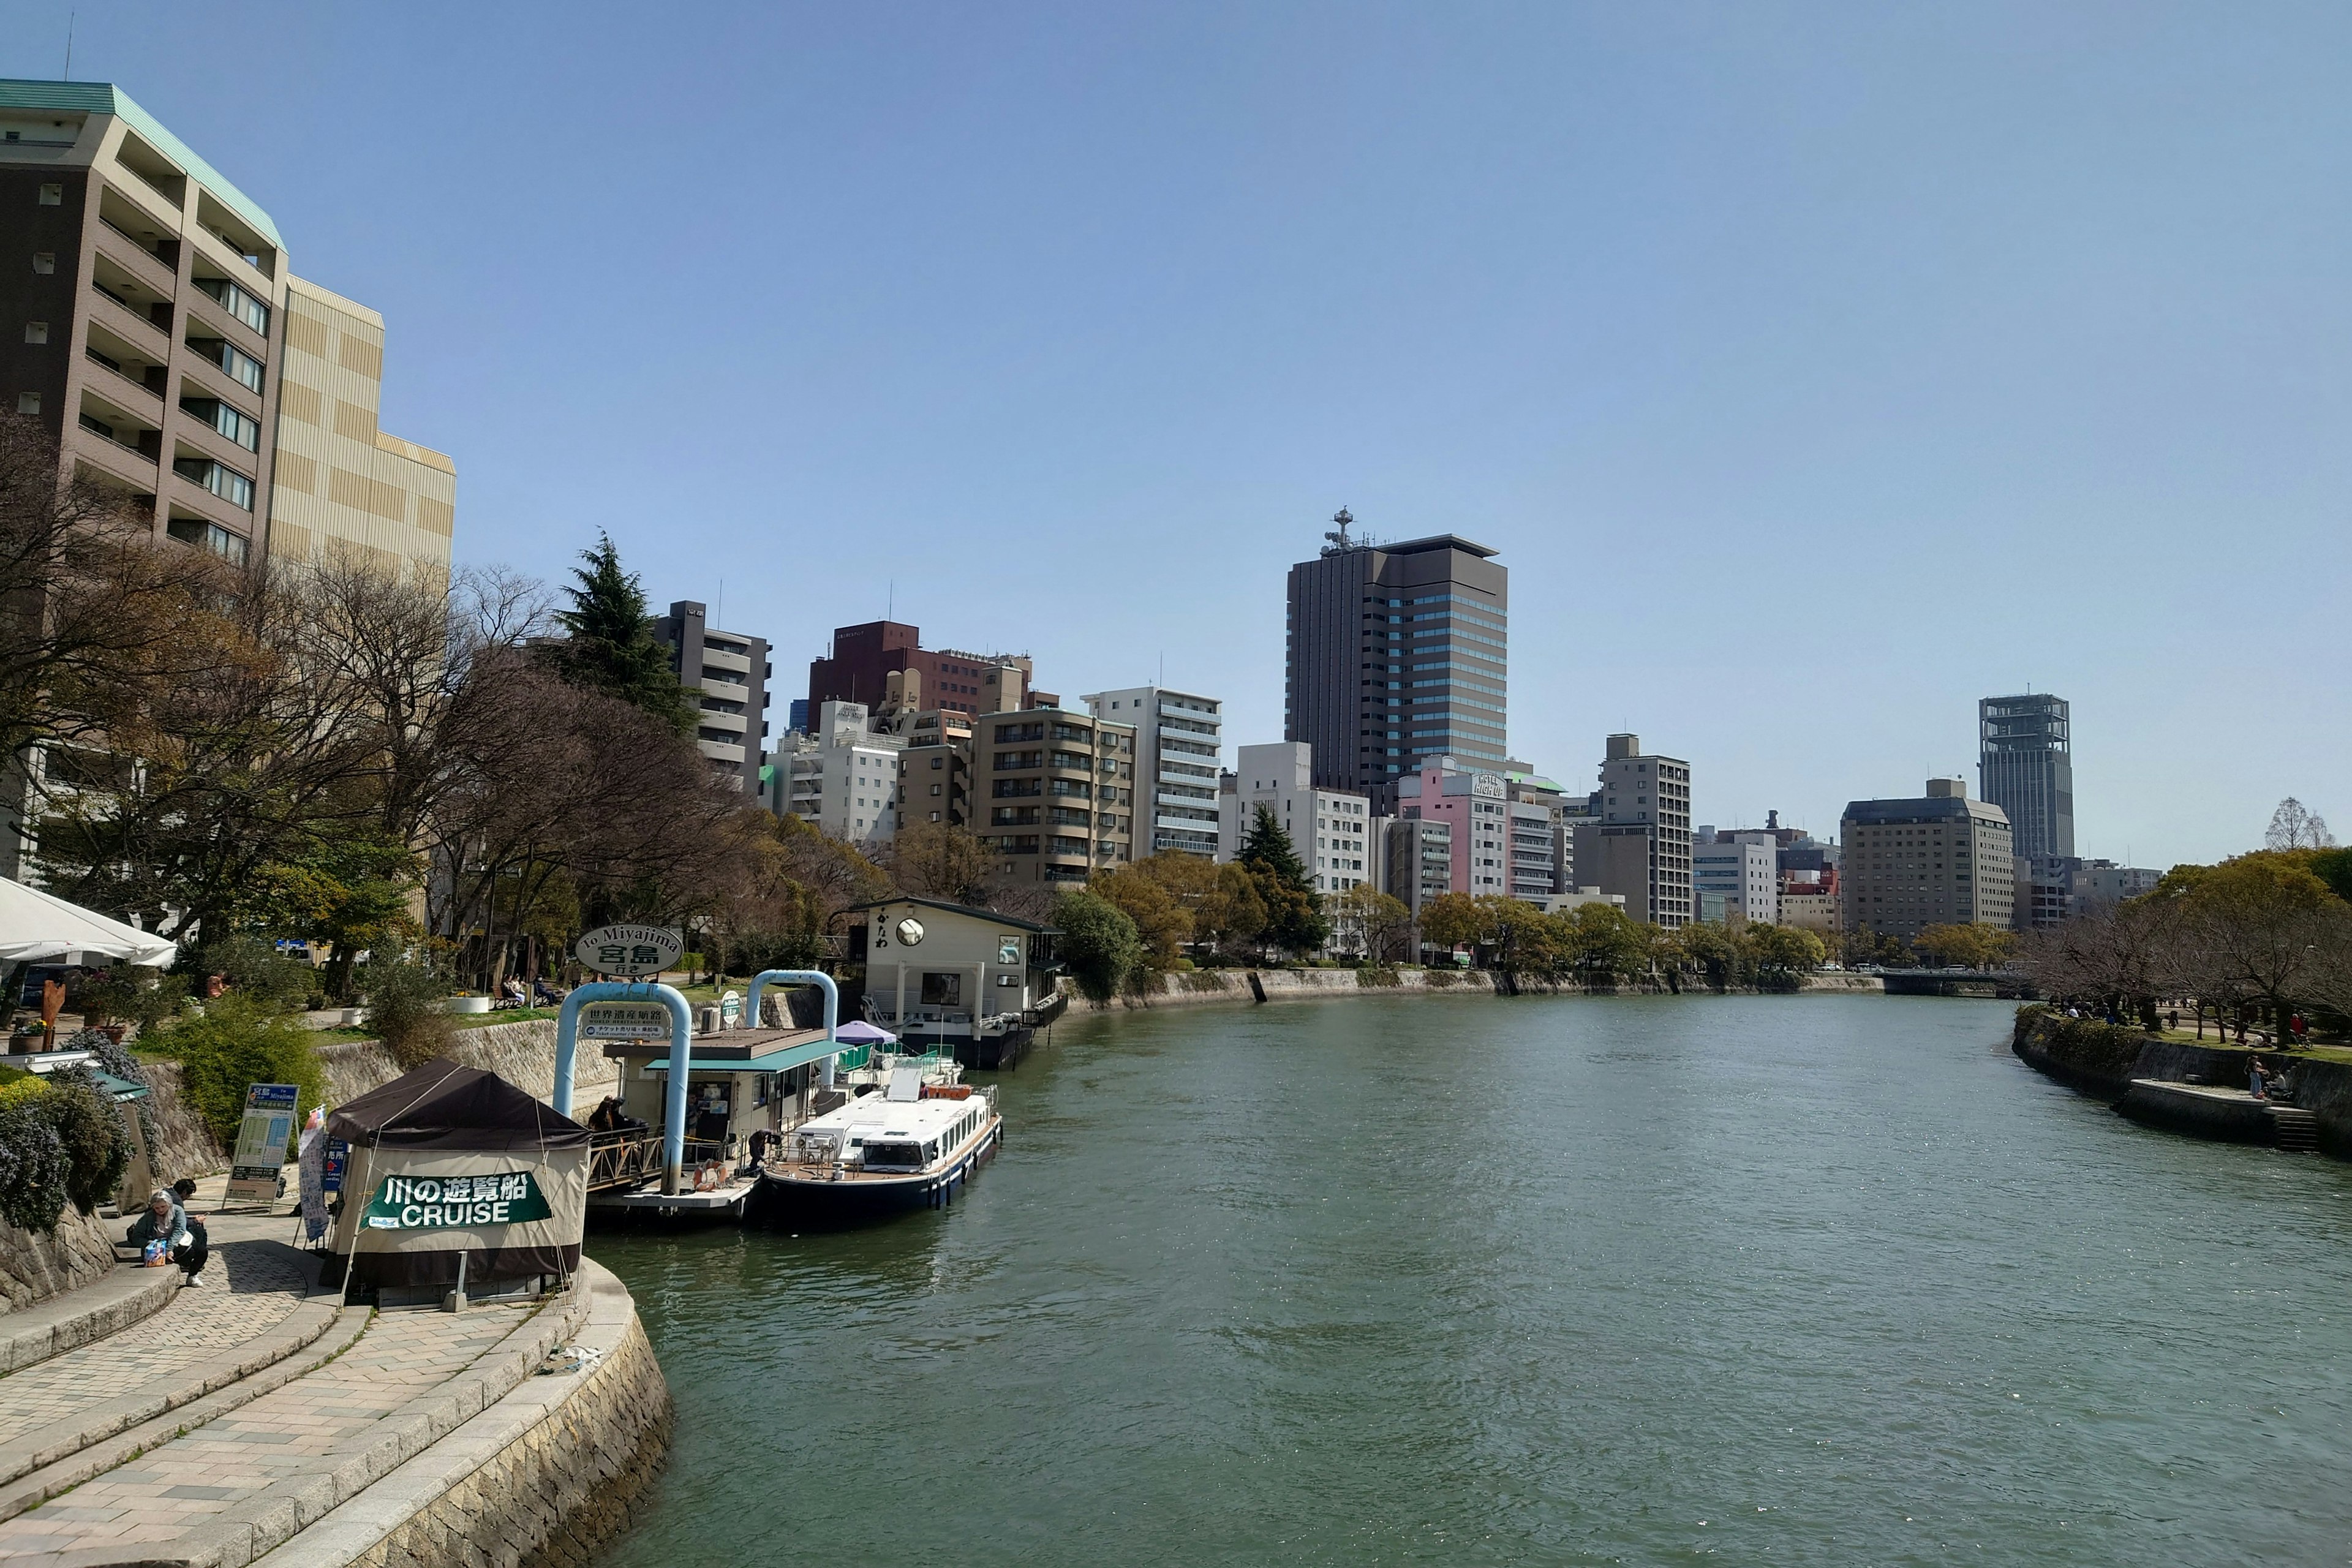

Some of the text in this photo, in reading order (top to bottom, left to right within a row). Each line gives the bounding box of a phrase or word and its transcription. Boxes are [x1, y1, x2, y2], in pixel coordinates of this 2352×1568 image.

[1479, 775, 1498, 785] HOTEL
[1474, 783, 1503, 796] HIGH UP
[581, 926, 678, 953] To Miyajima
[598, 944, 659, 964] 宮島
[615, 964, 640, 974] 行き
[590, 1009, 661, 1020] 世界遺産航路
[384, 1174, 529, 1205] 川の遊覧船
[401, 1201, 510, 1226] CRUISE
